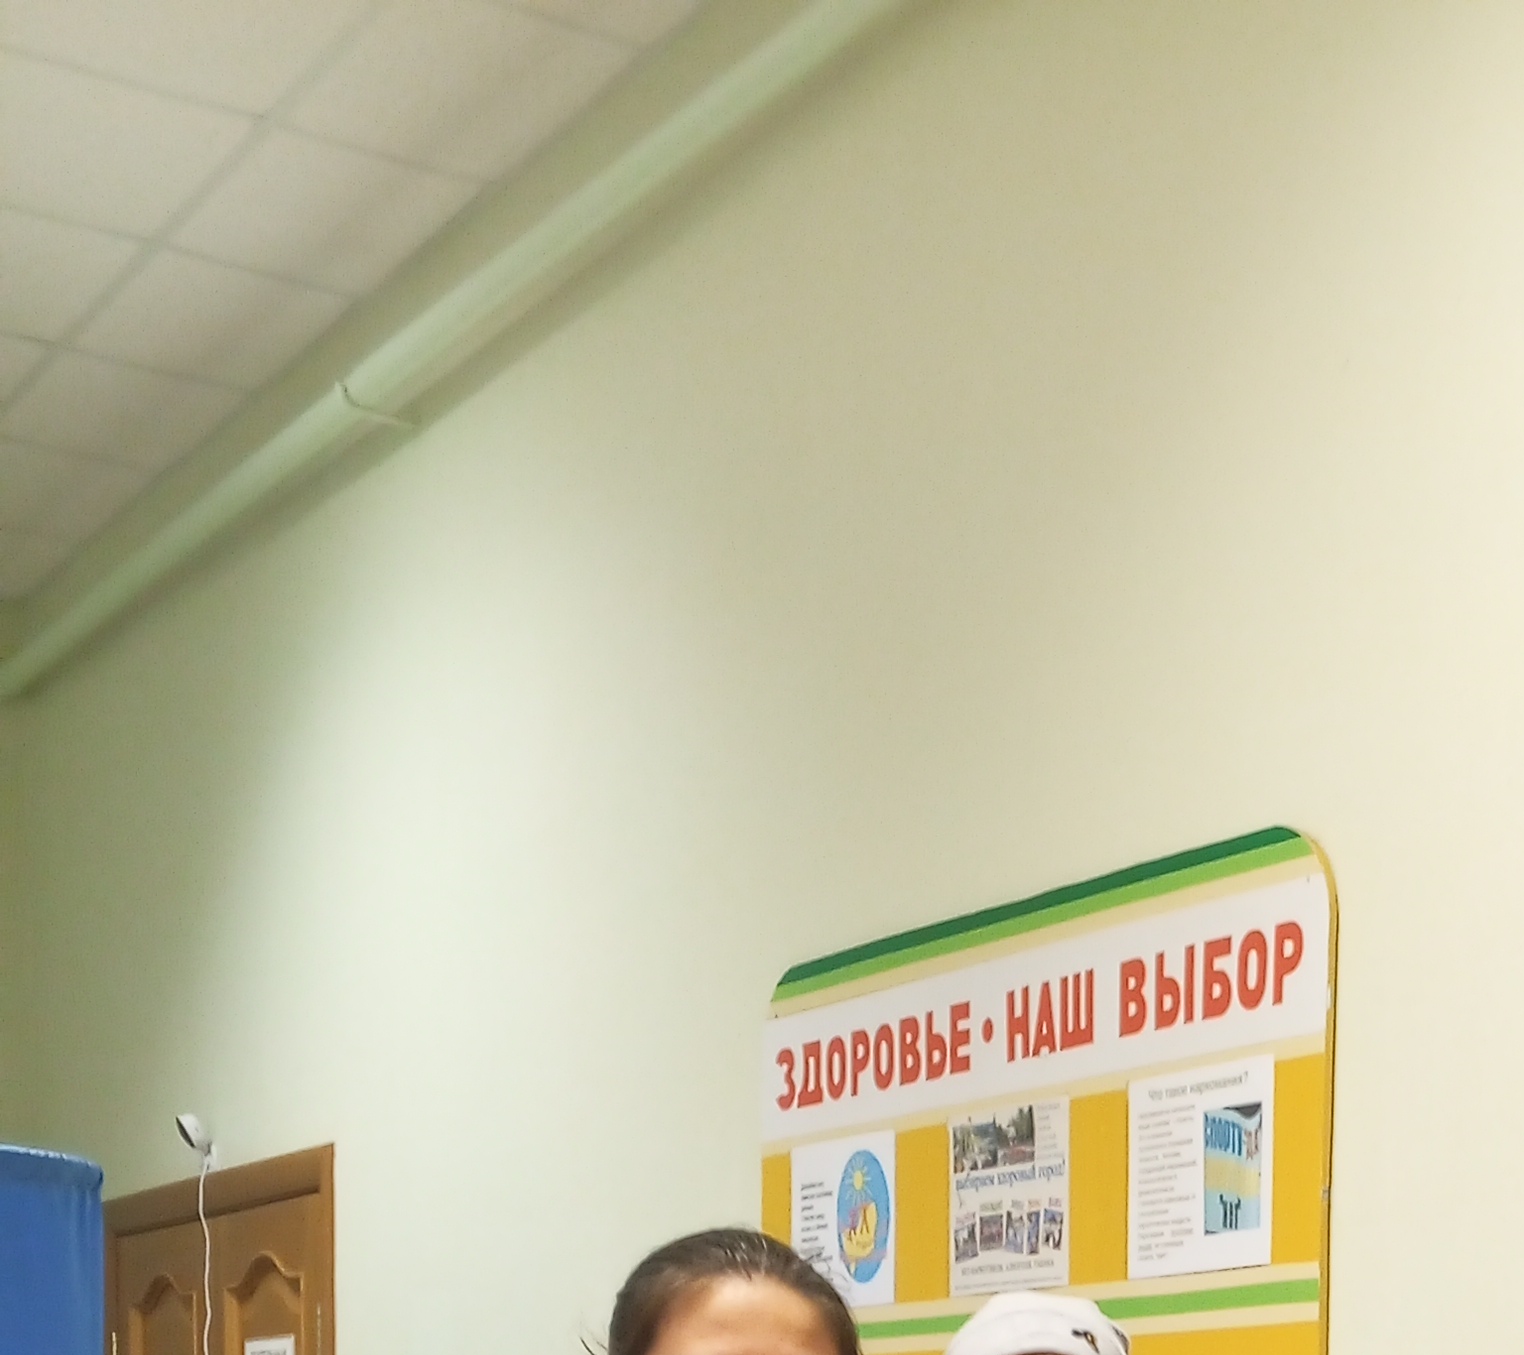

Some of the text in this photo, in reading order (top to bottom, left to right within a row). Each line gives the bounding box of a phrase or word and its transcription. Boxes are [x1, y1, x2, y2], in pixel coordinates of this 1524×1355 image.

[776, 920, 1305, 1111] ЗДОРОВЬЕ НАШ ВЫБОР
